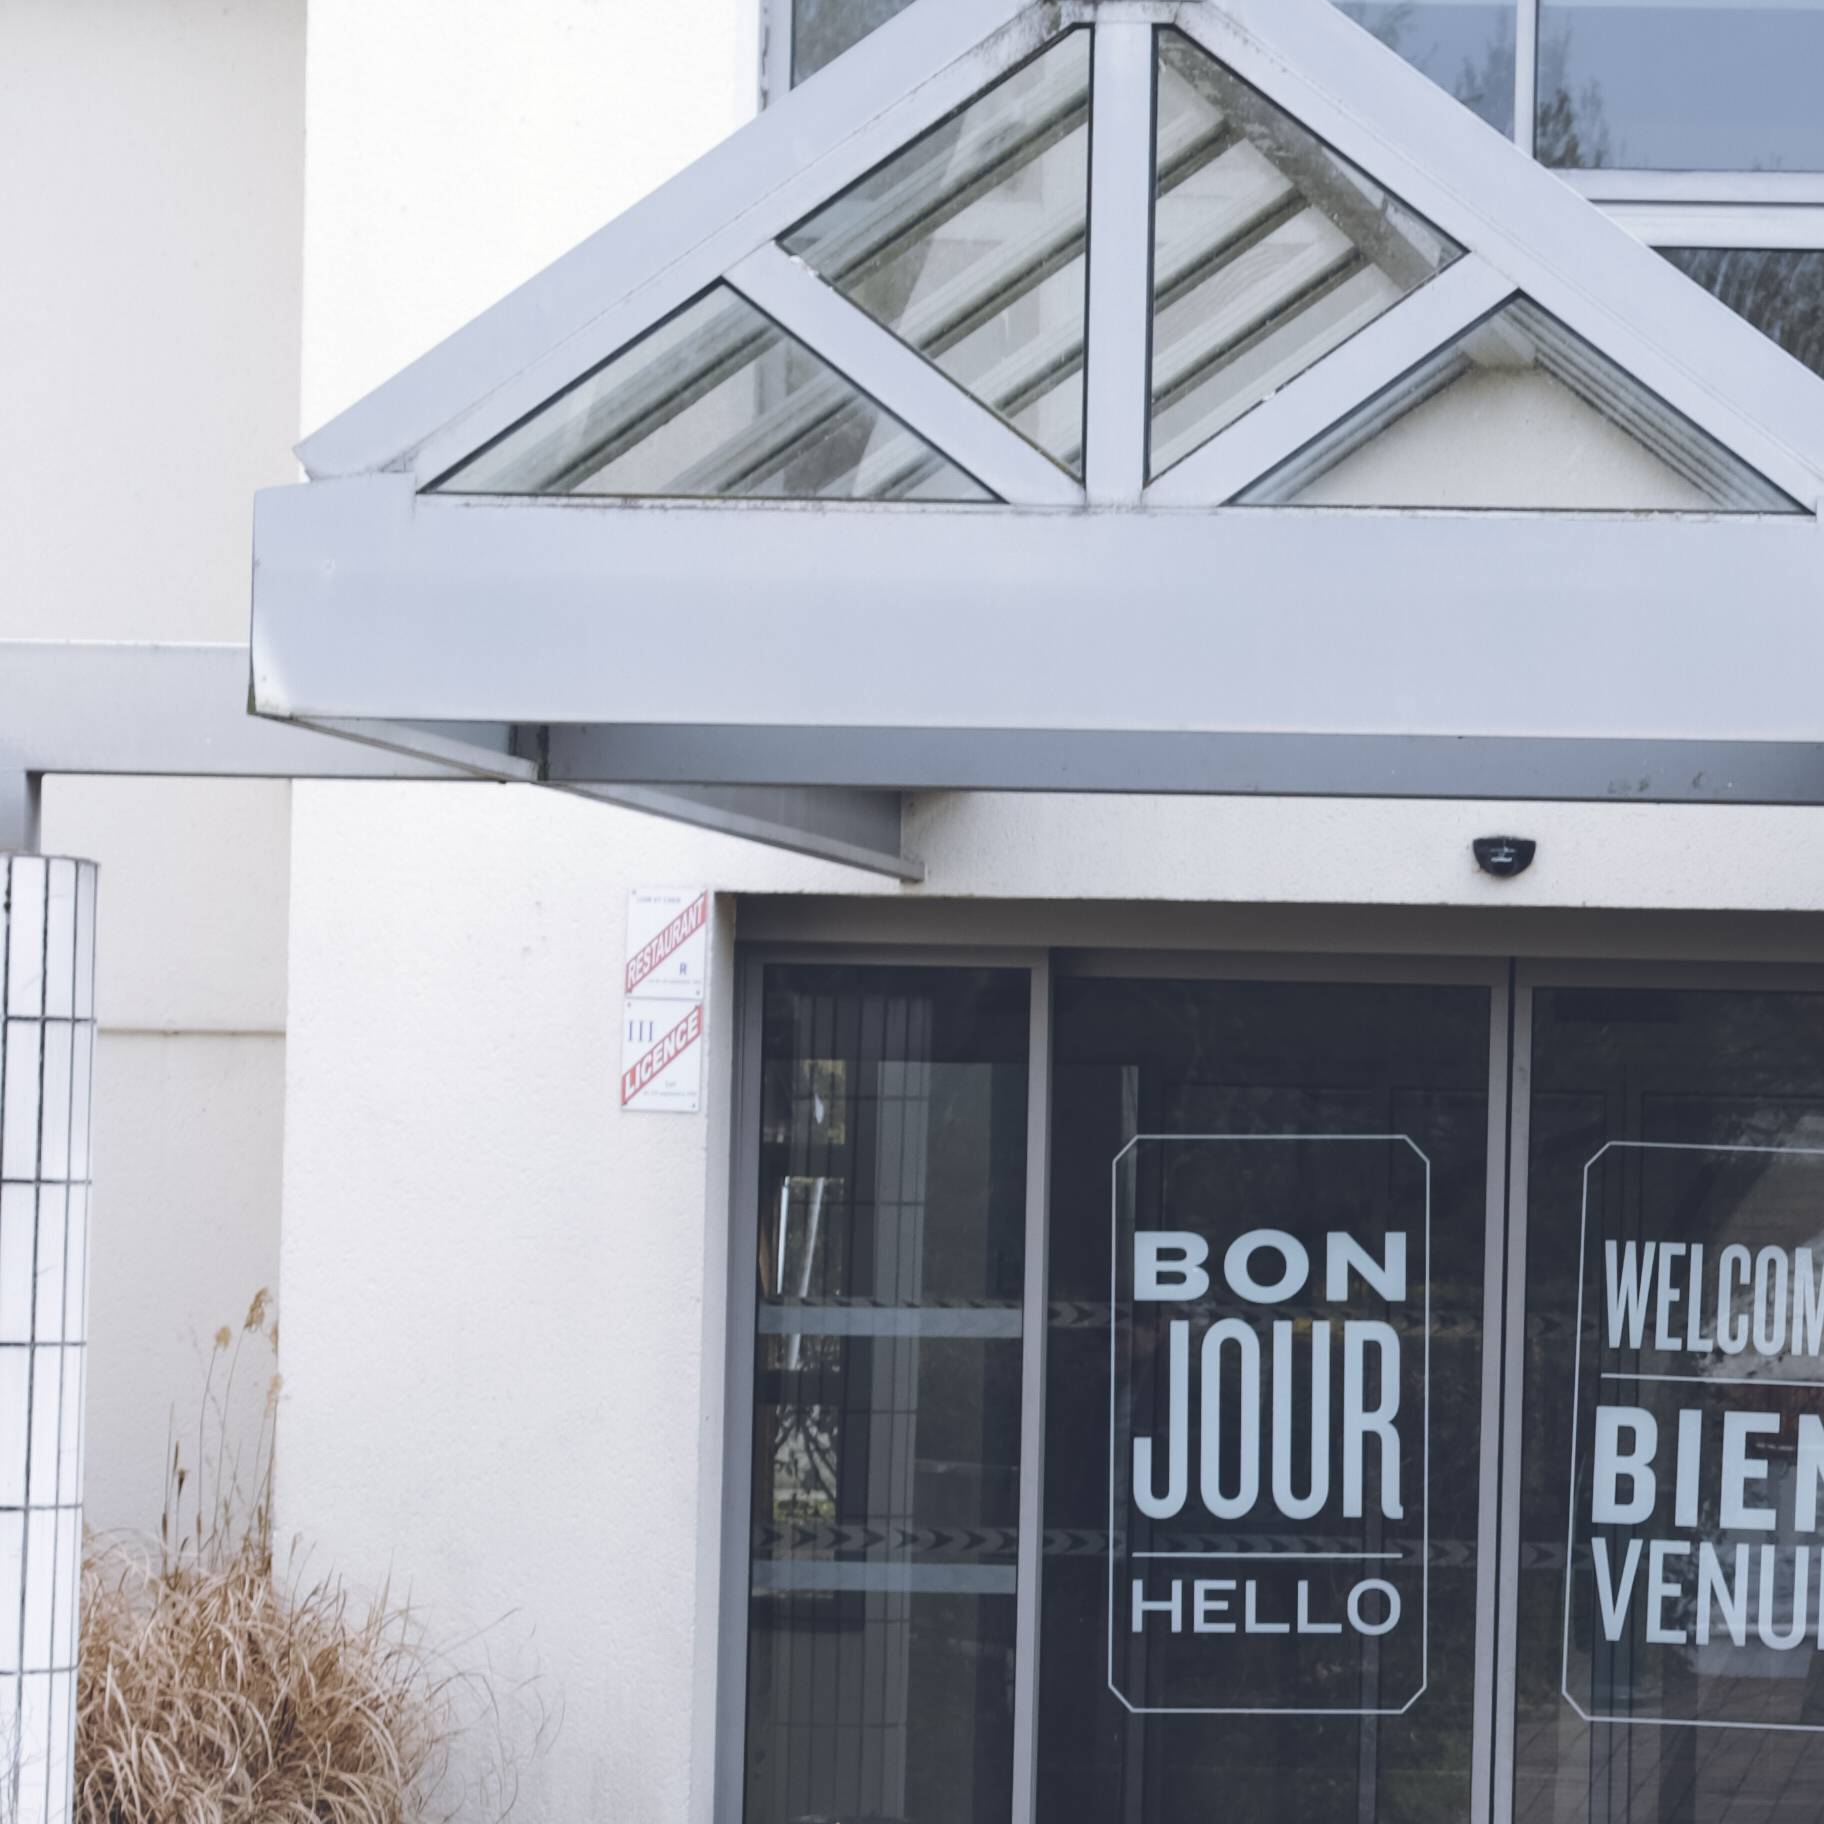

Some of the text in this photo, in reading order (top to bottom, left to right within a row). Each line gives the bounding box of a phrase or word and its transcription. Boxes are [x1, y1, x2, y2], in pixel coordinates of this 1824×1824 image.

[626, 895, 704, 993] RESTAURANT
[679, 962, 687, 976] R
[624, 1007, 699, 1102] LICENCE
[627, 1019, 654, 1043] III
[1133, 1229, 1407, 1304] BON
[1132, 1317, 1404, 1520] JOUR
[1132, 1578, 1401, 1636] HELLO
